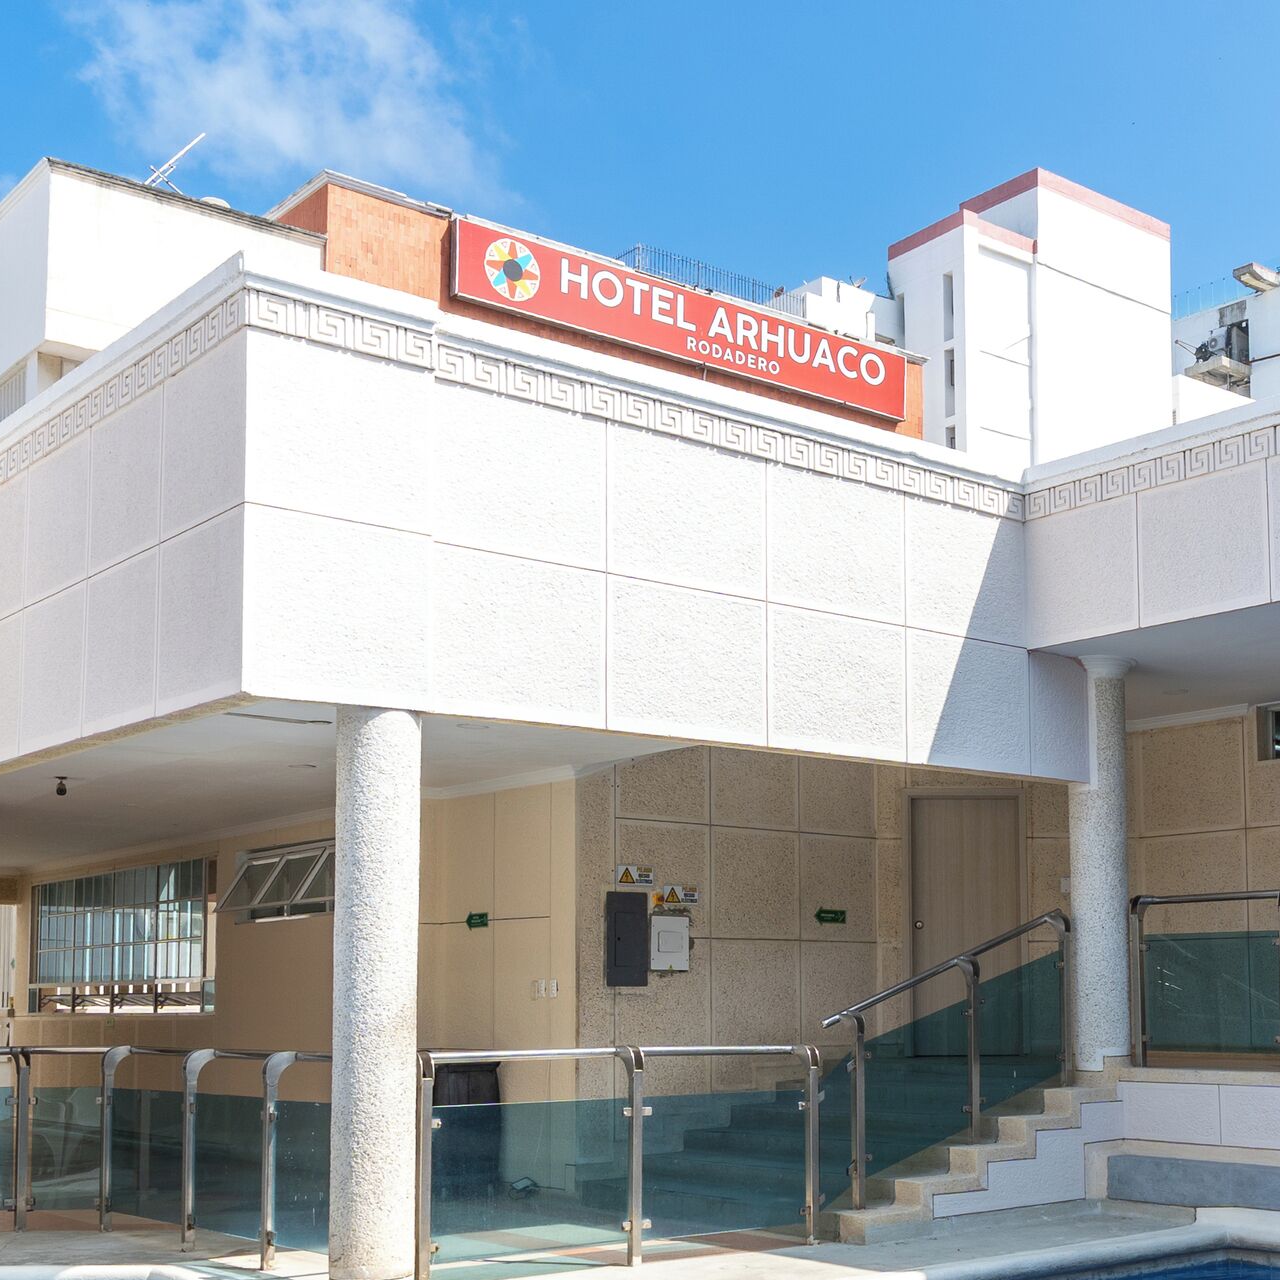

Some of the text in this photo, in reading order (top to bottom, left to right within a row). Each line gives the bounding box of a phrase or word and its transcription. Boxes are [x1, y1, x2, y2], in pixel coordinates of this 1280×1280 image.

[559, 257, 886, 386] HOTEL ARHUACO
[686, 336, 780, 376] RODADERO
